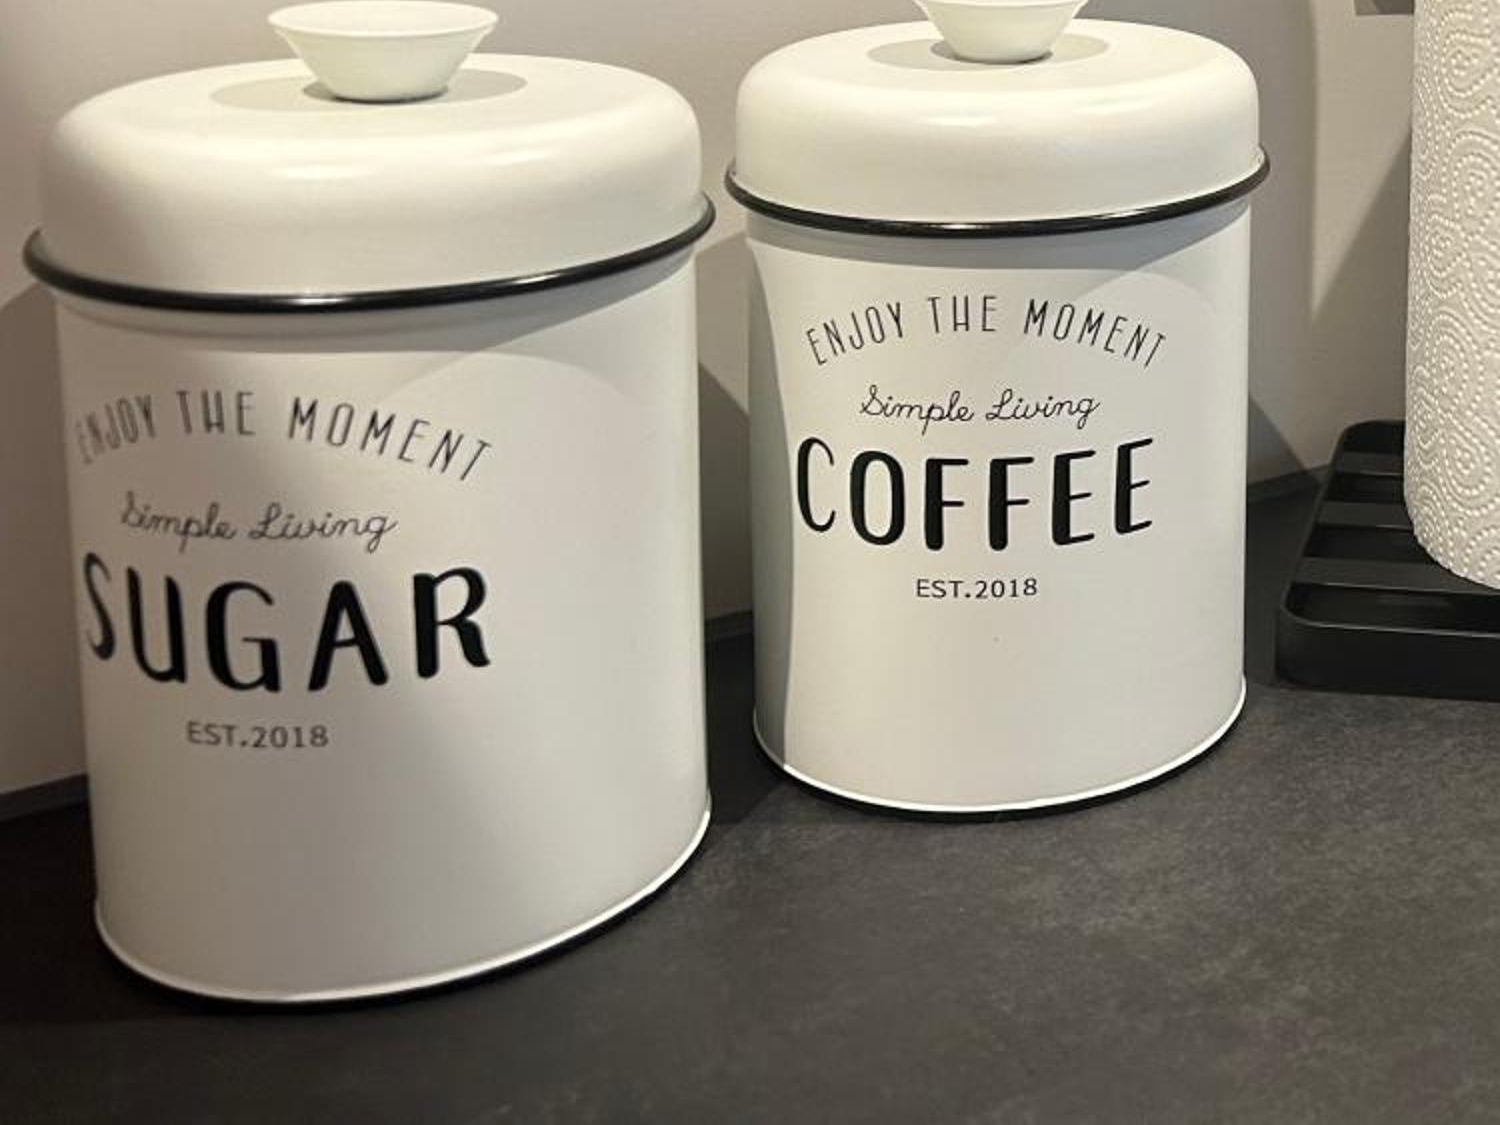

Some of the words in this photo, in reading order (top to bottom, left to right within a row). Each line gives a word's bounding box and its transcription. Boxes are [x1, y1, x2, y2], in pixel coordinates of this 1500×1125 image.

[805, 302, 903, 366] ENJOY
[927, 295, 998, 334] THE
[1023, 298, 1168, 368] MOMENT
[75, 394, 157, 465] ENJOY
[176, 390, 257, 436] THE
[288, 396, 495, 482] MOMENT
[860, 384, 975, 435] Simple
[985, 388, 1101, 429] Living
[120, 491, 237, 553] Simple
[248, 501, 397, 553] Living
[797, 436, 1154, 552] COFFEE
[82, 551, 492, 693] SUGAR
[916, 577, 1039, 600] EST.2018
[186, 720, 330, 750] EST.2018
